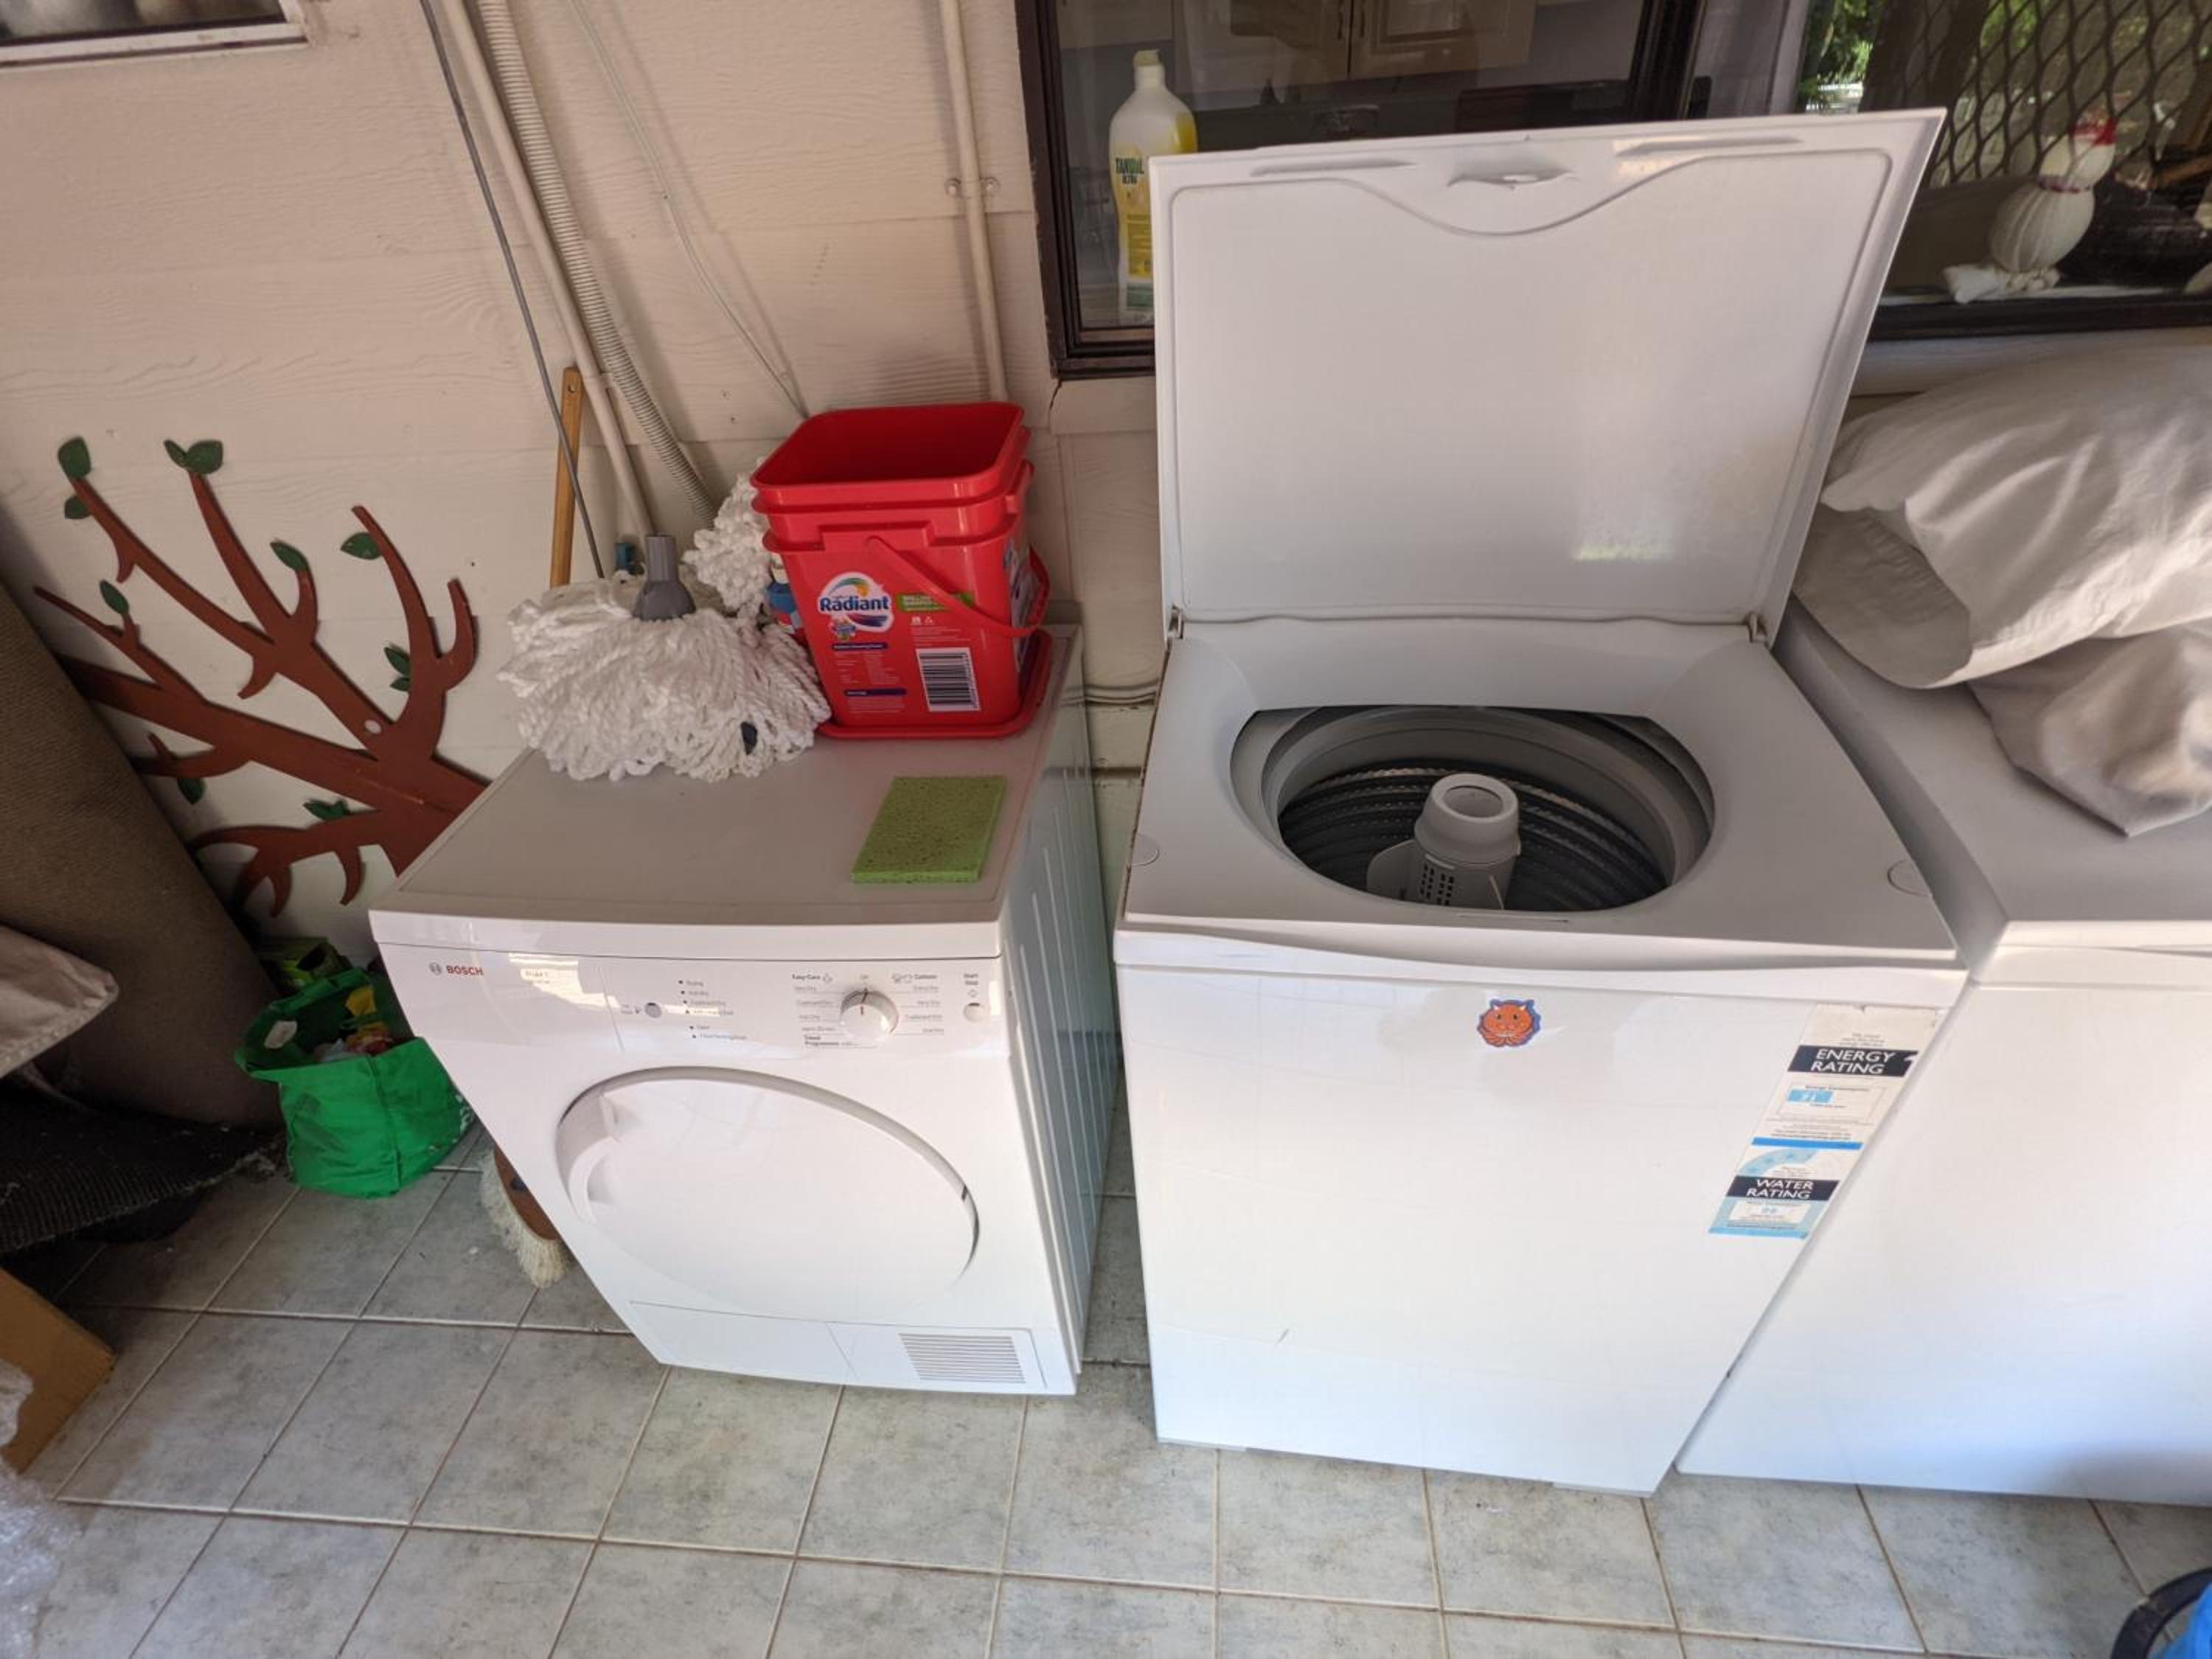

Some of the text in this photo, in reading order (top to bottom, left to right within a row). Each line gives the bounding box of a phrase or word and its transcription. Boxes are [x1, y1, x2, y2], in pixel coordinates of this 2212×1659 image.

[819, 596, 889, 612] Radiant
[445, 964, 484, 976] BOSCH
[1815, 1048, 1896, 1063] ENERGY
[1810, 1061, 1885, 1074] RATING
[1756, 1179, 1815, 1190] WATER
[1746, 1188, 1812, 1200] RATING
